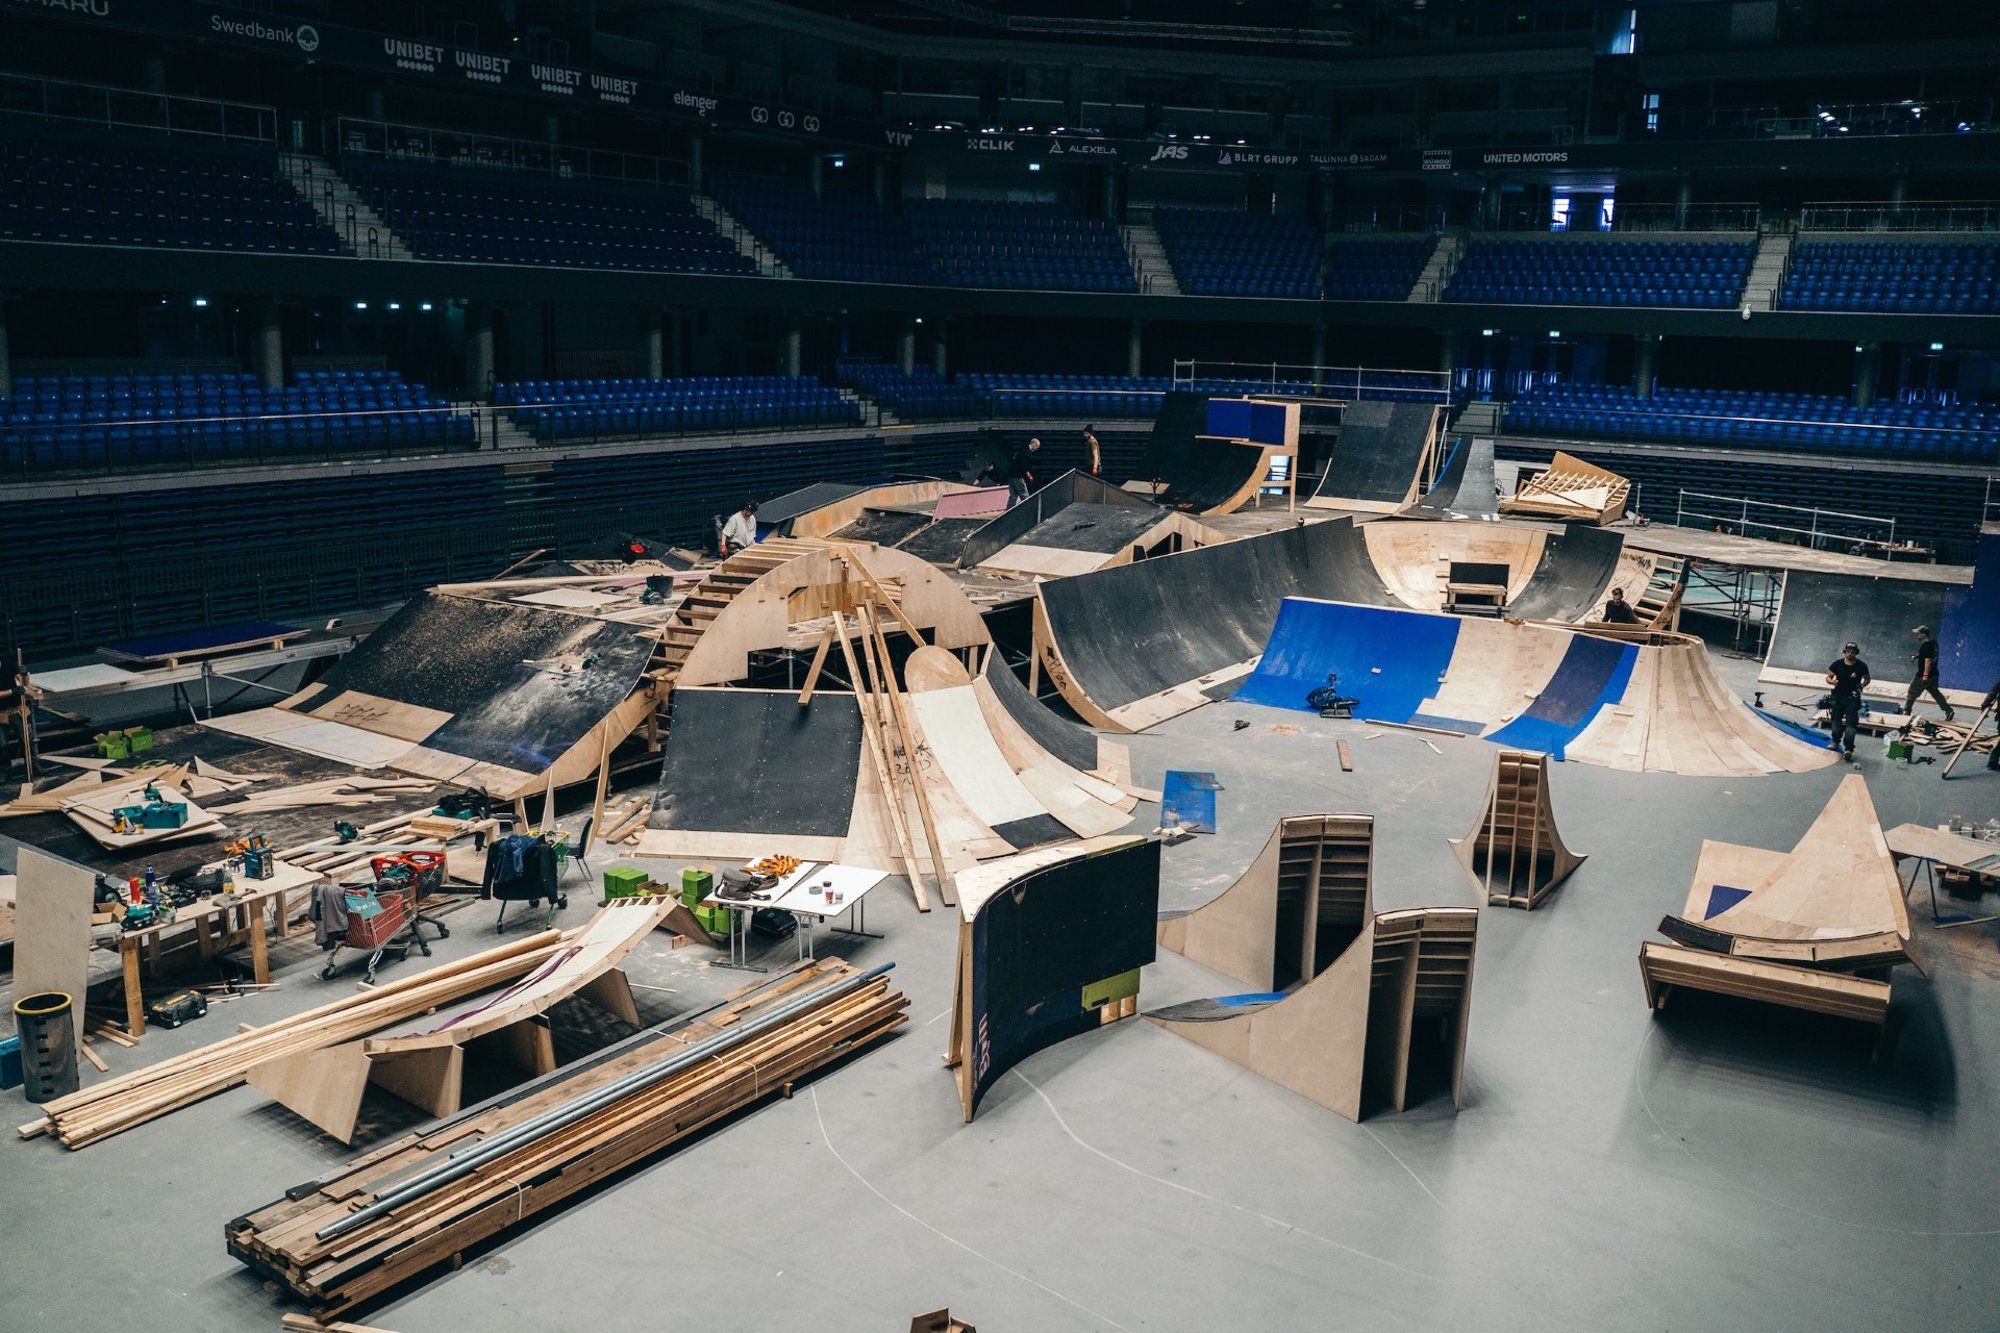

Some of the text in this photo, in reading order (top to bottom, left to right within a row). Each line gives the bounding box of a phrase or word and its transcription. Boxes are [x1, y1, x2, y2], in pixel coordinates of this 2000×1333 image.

[24, 0, 109, 16] ARU
[210, 14, 295, 43] Swedbank
[384, 38, 444, 63] UNIBET
[455, 50, 511, 74] UNIBET
[531, 64, 582, 86] UNIBET
[591, 74, 638, 96] UNIBET
[673, 89, 718, 117] elenger
[885, 130, 913, 147] YIT
[976, 139, 1015, 151] CLIK
[1069, 145, 1118, 155] ALEXELA
[1150, 142, 1189, 161] JAS
[1234, 152, 1298, 165] BLRT GRUPP
[1310, 154, 1388, 164] TALLINNA SADAM
[1522, 152, 1568, 164] MOTORS
